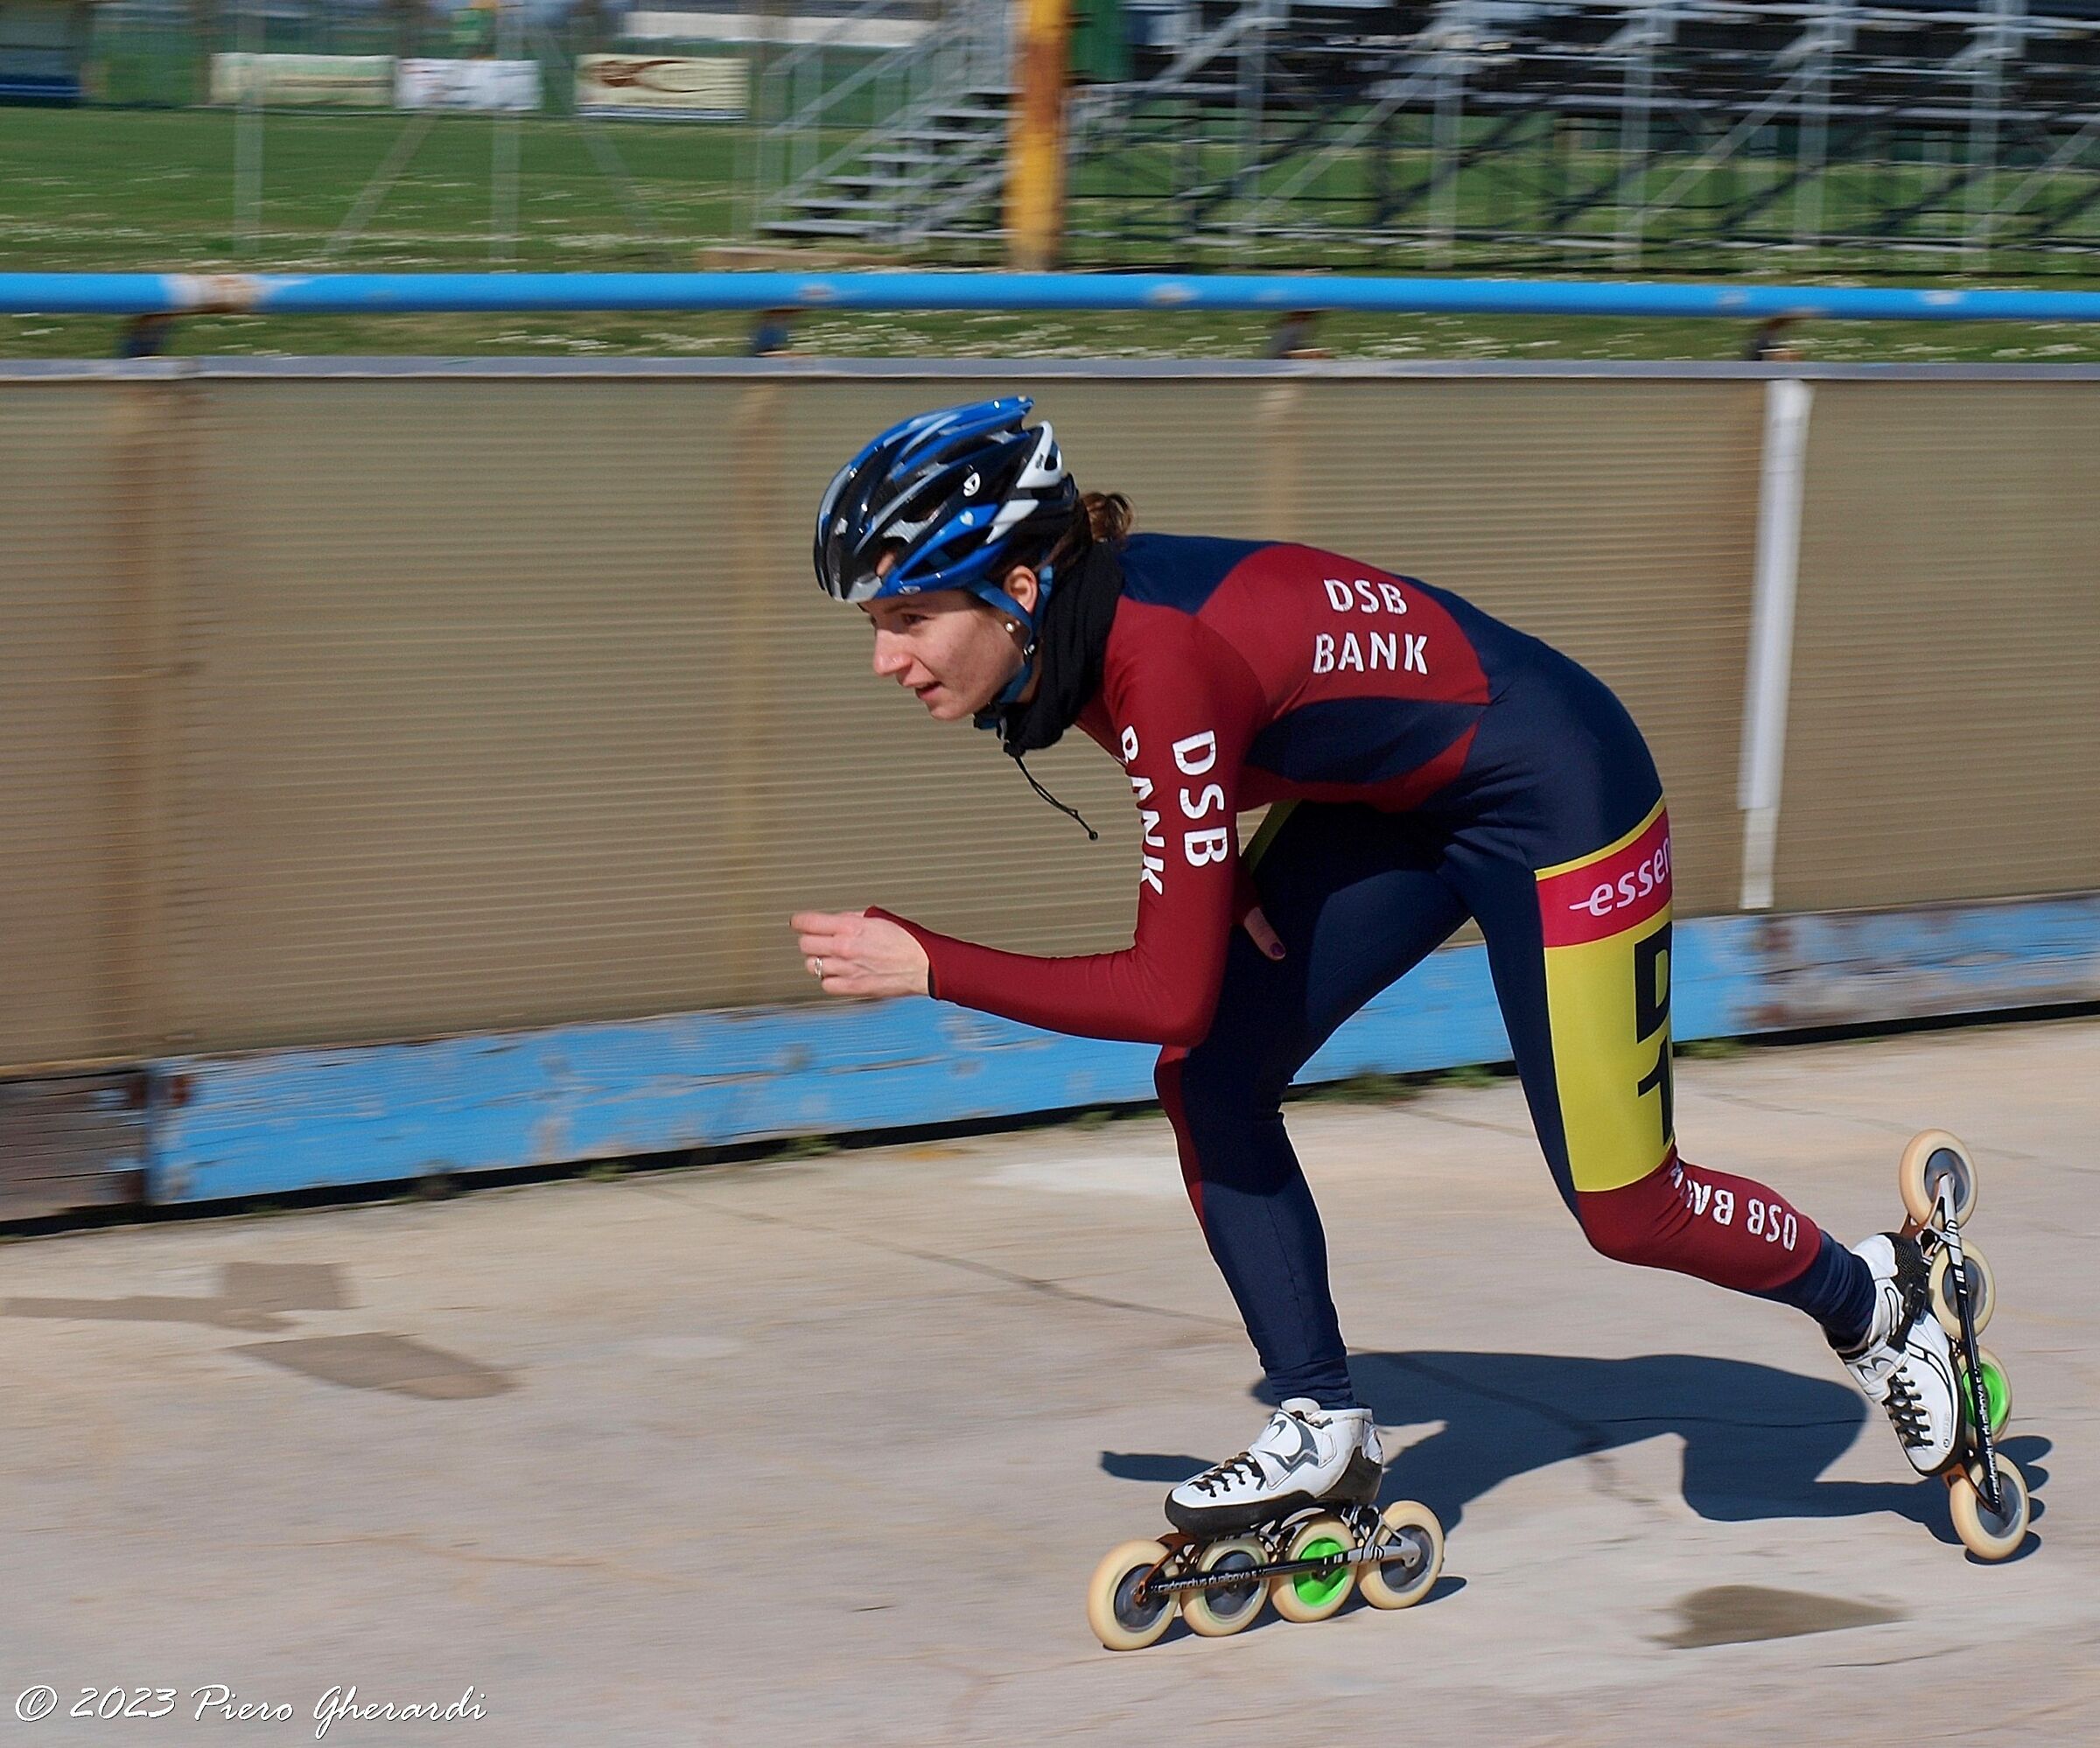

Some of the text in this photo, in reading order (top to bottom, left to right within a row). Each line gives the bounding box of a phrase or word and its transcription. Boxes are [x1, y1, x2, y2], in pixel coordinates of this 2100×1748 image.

[1323, 578, 1408, 615] DSB
[1312, 631, 1428, 675] BANK
[1172, 730, 1228, 868] DSB
